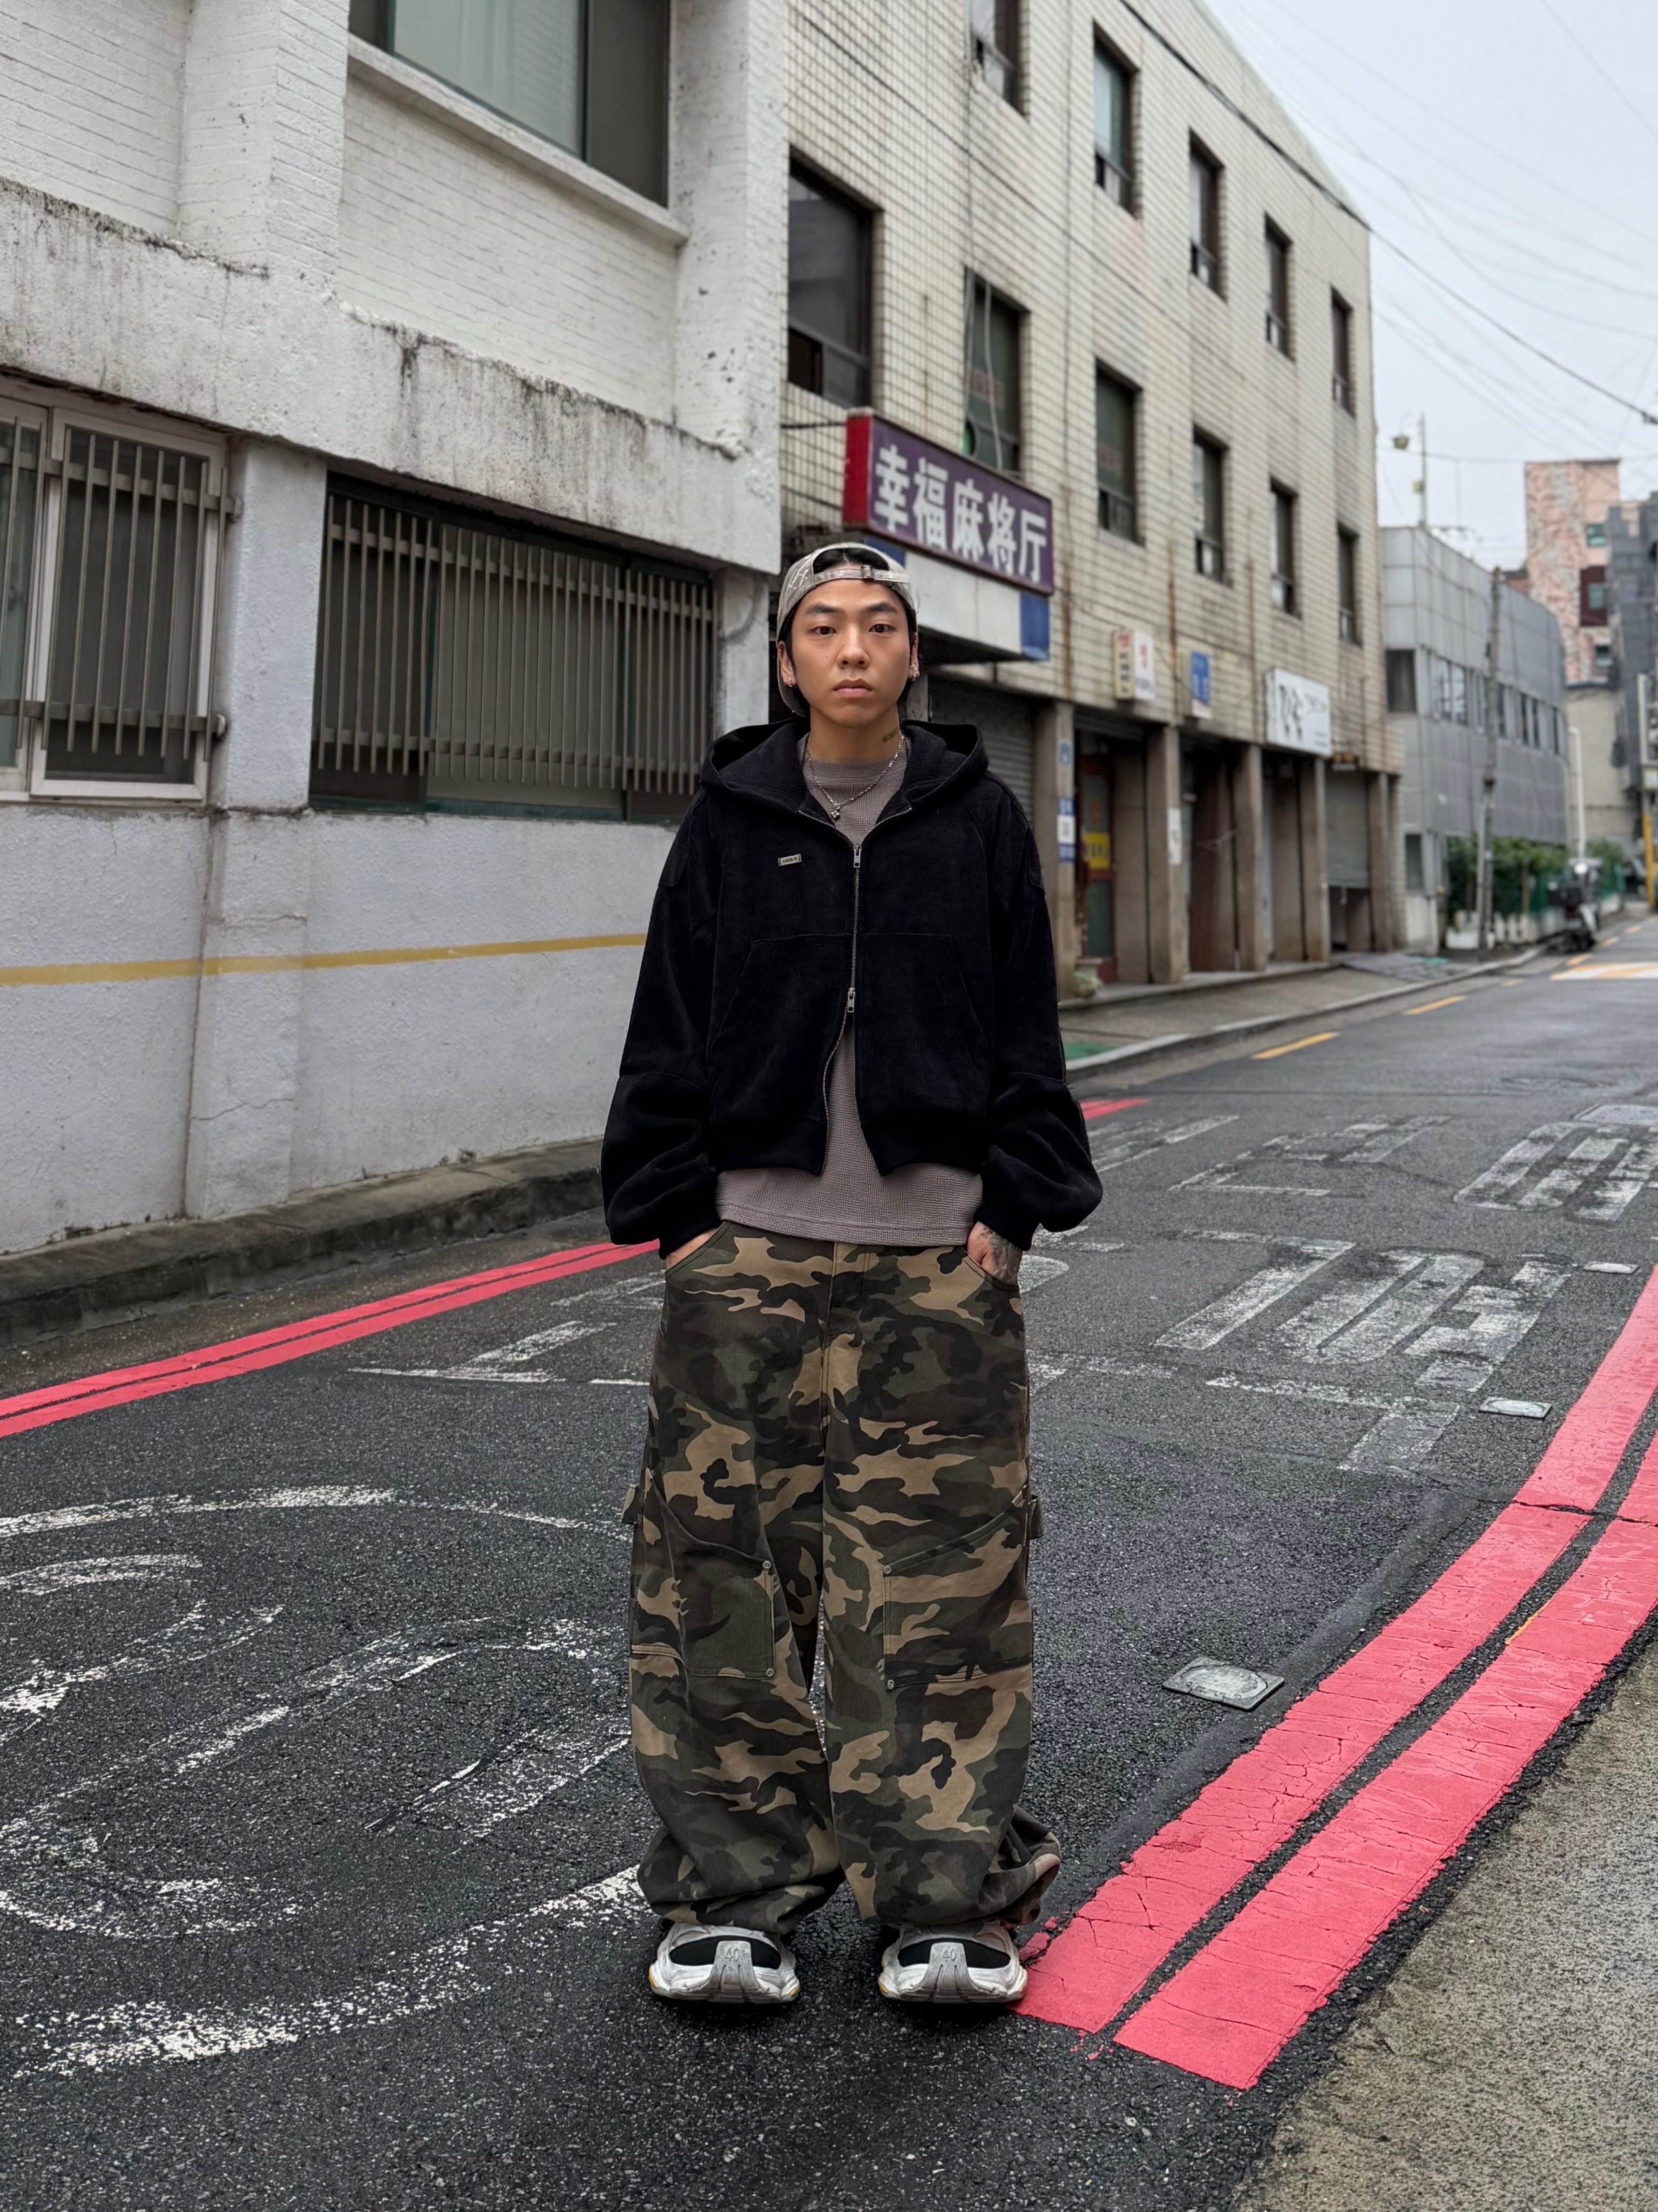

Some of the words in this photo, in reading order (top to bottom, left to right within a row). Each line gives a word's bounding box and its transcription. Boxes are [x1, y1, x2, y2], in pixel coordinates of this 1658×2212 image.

[875, 444, 1046, 583] 幸福麻将厅
[725, 1947, 740, 1961] 40
[943, 1948, 957, 1961] 40
